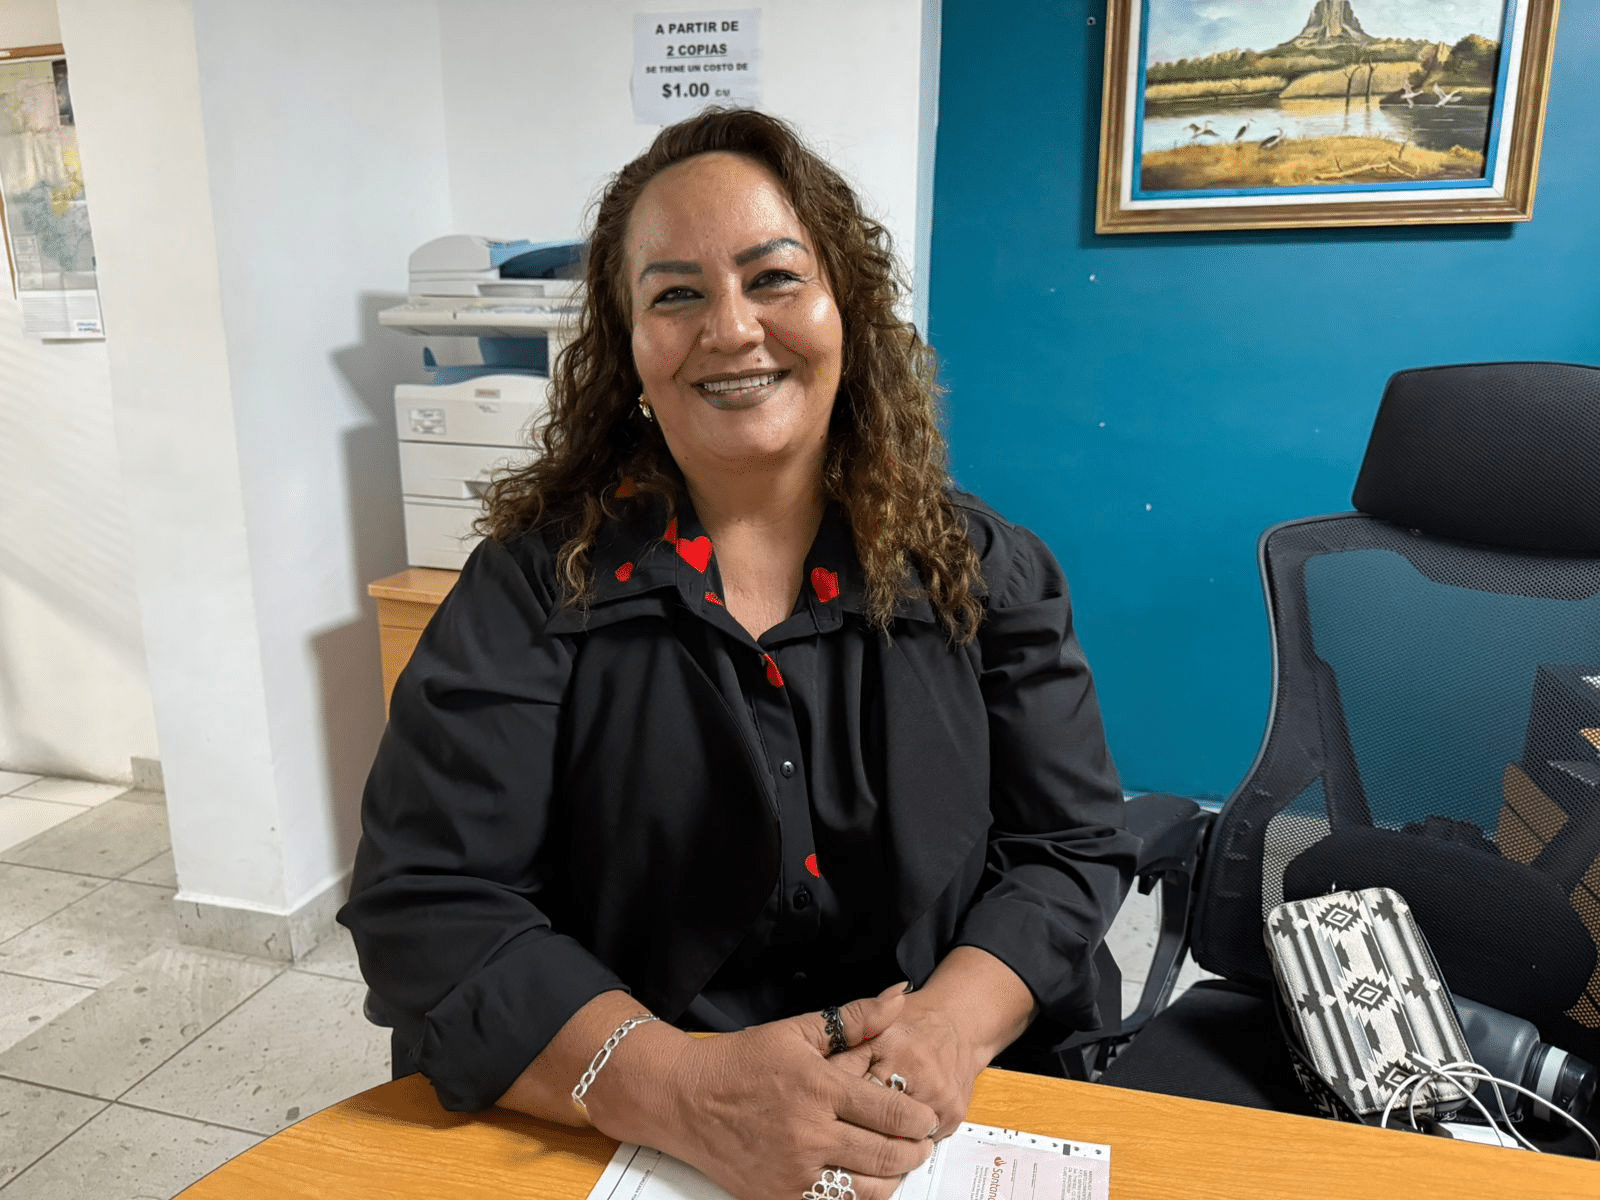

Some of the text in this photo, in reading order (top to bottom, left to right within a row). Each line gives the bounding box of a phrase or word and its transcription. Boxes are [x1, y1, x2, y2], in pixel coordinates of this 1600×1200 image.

[655, 21, 739, 35] A PARTIR DE
[666, 44, 728, 57] 2 COPIAS
[645, 63, 748, 74] SE TIENE UN COSTO DE
[662, 83, 710, 99] $1.00
